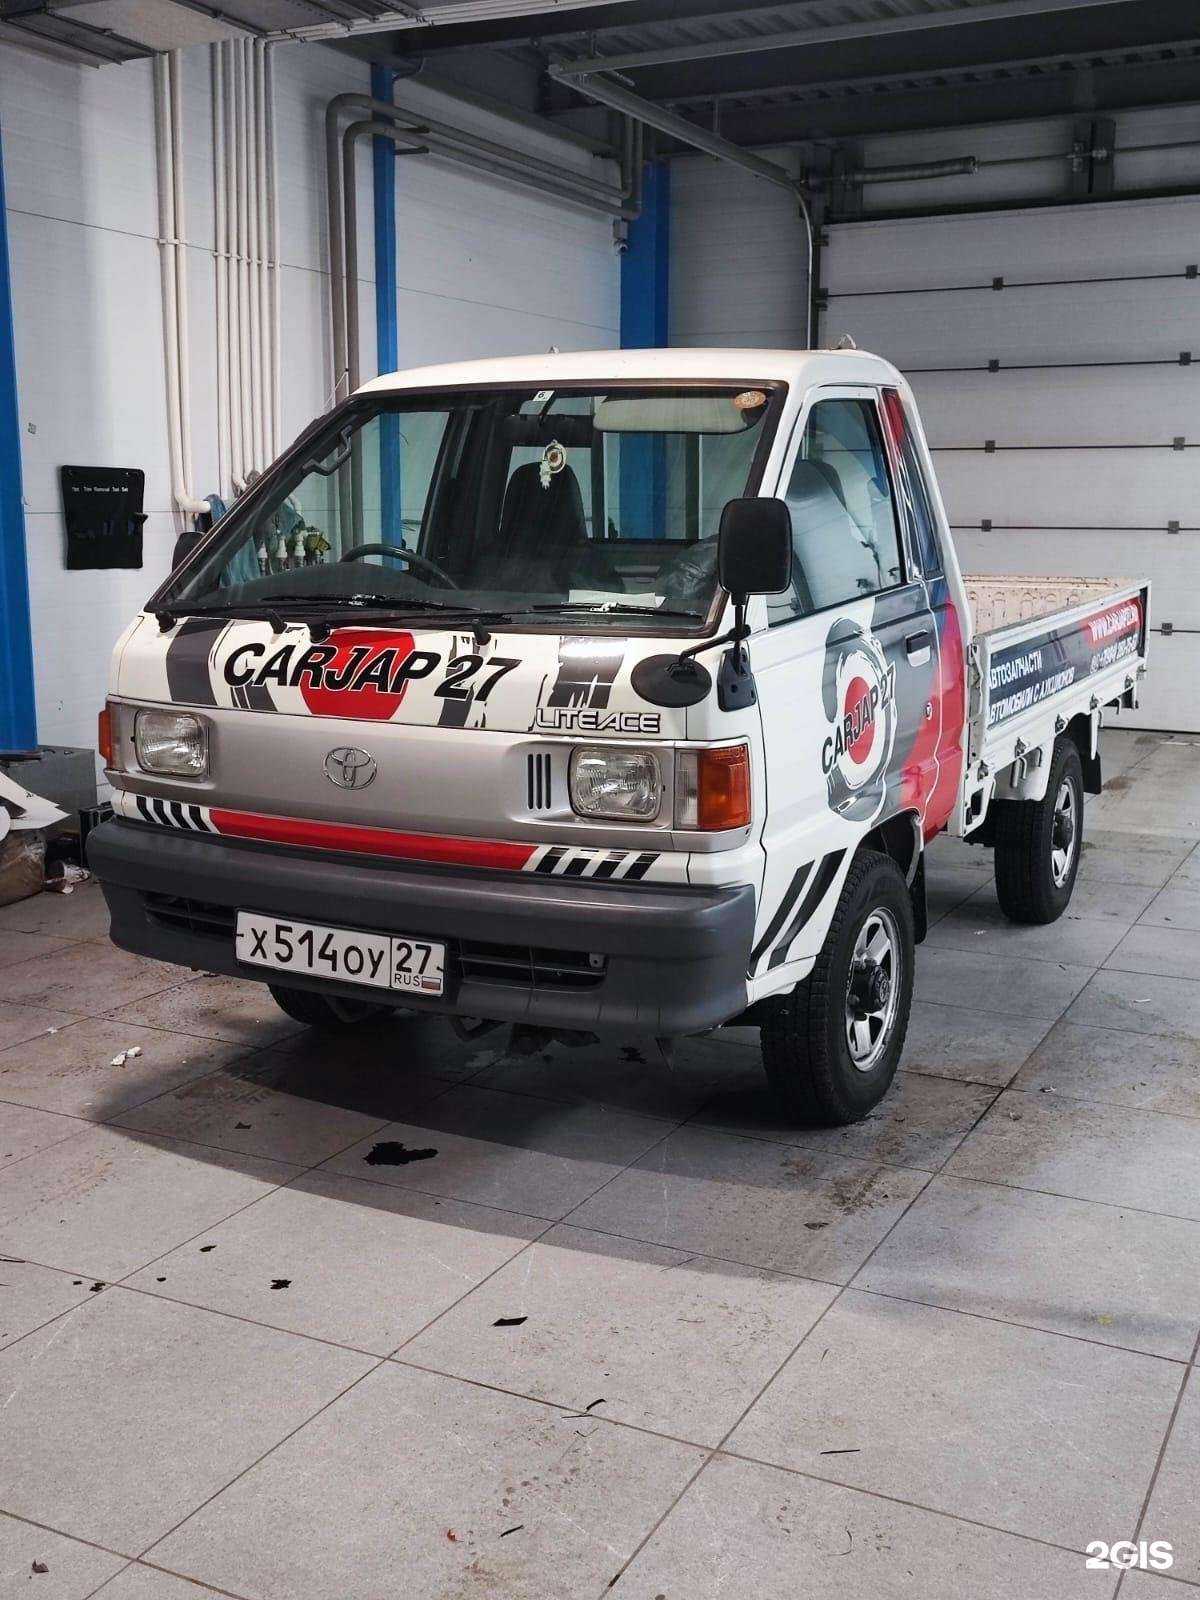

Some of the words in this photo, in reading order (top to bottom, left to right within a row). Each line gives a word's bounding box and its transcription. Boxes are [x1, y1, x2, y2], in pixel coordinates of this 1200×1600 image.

[223, 643, 441, 695] CARJAP
[434, 653, 523, 703] 27
[536, 707, 661, 734] LITEACE
[822, 684, 879, 775] CARJAP
[879, 661, 896, 711] 27
[396, 943, 432, 975] 27
[394, 973, 421, 986] RUS
